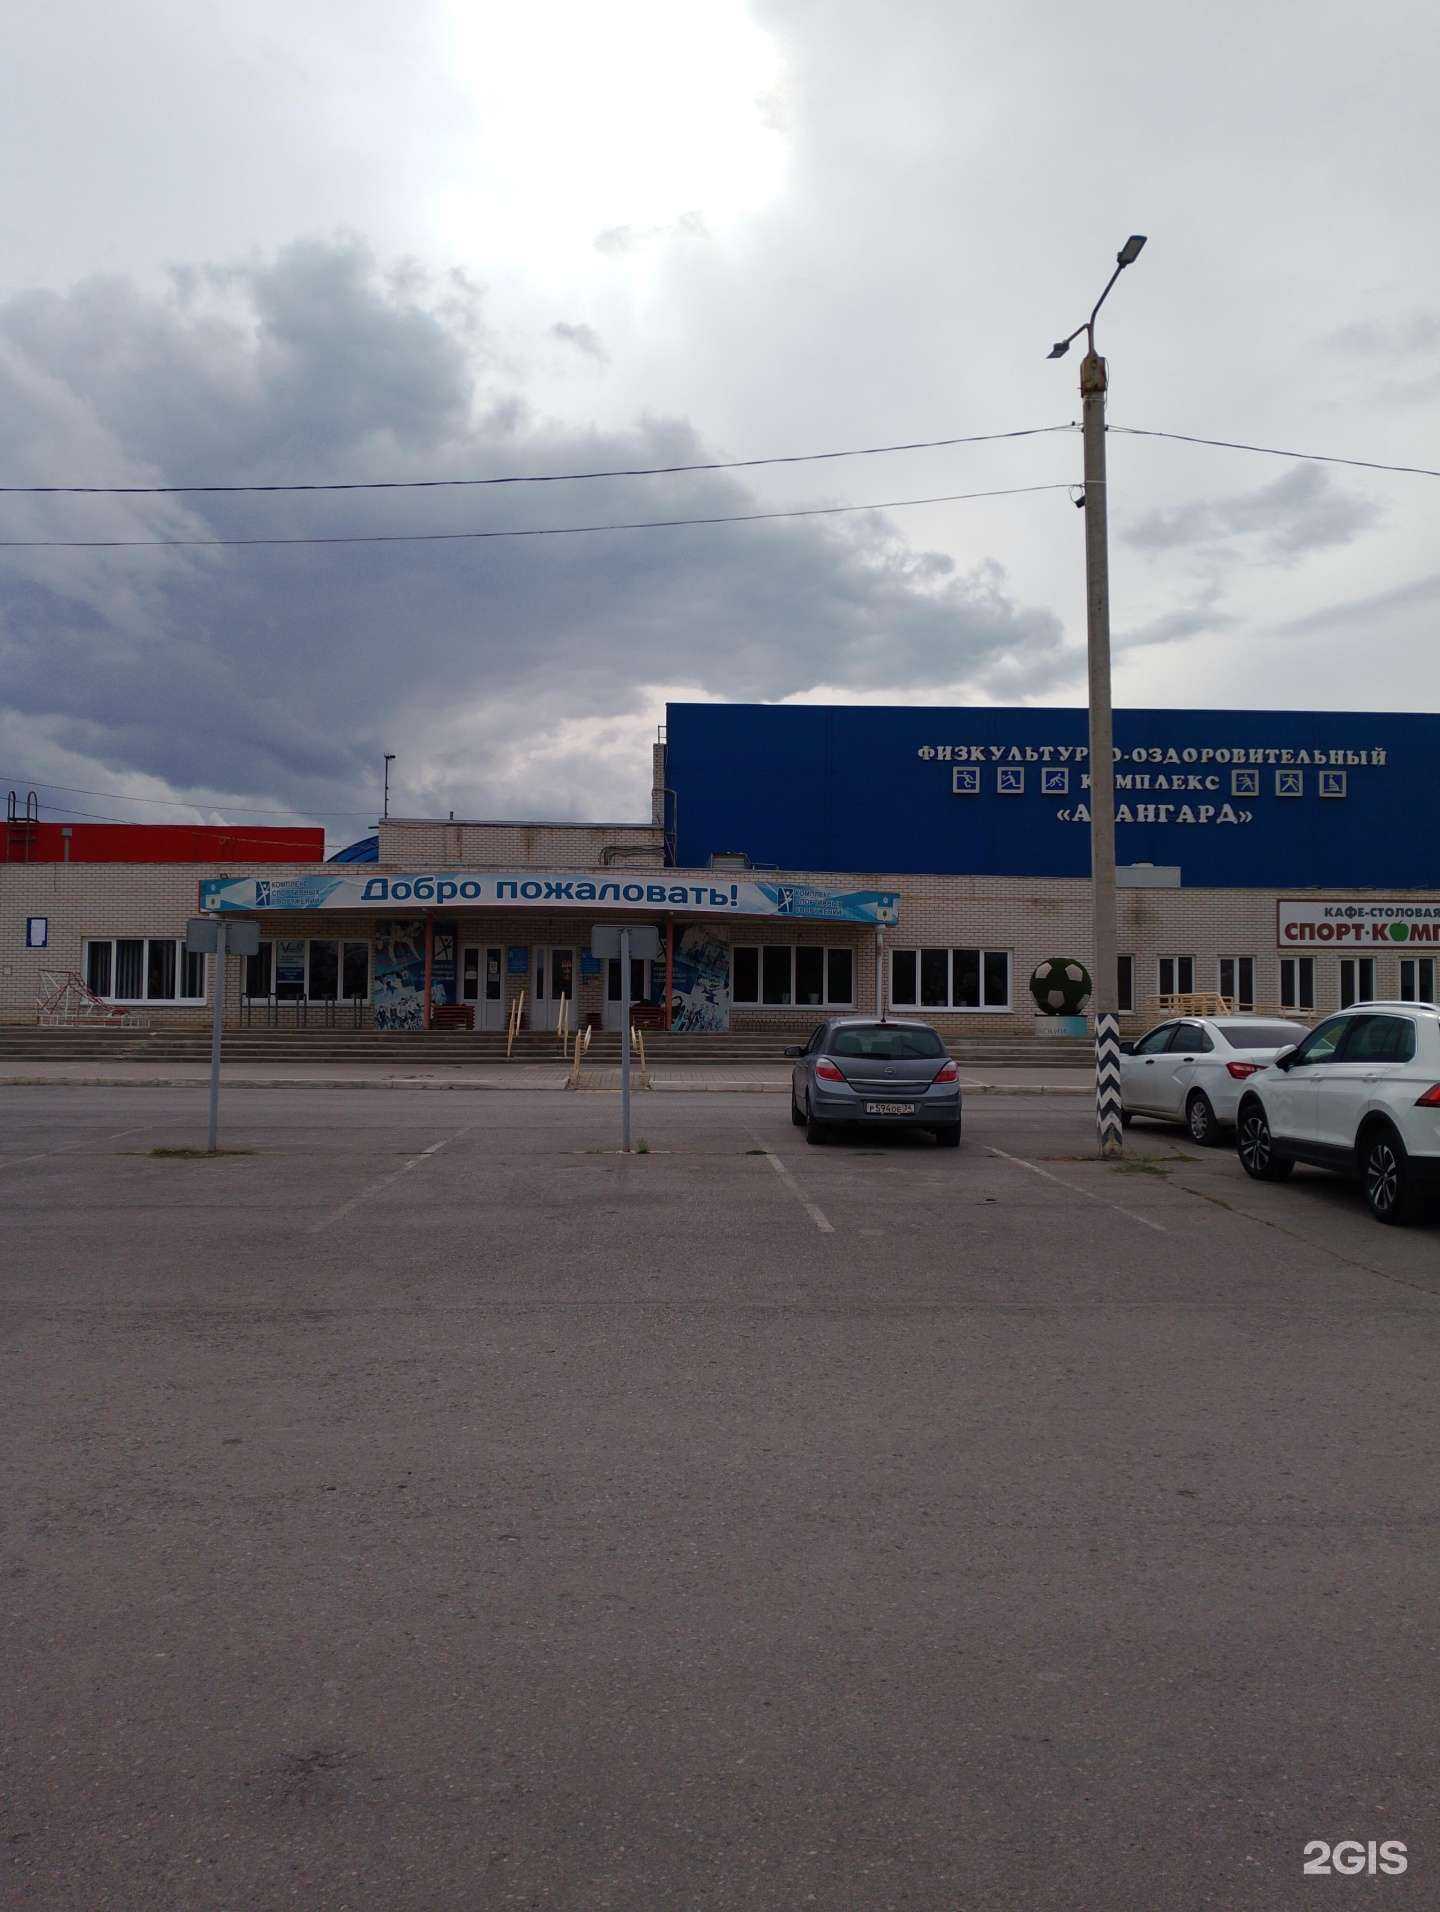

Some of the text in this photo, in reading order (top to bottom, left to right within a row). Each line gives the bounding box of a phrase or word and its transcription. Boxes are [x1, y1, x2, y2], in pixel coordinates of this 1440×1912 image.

[917, 744, 1388, 766] ФИЗКУЛЬТУРО-ОЗДОРОВИТЕЛЬНЫЙ
[1080, 773, 1221, 791] КМПЛЕКС
[1056, 803, 1253, 825] «ААНГАРД»
[361, 876, 738, 907] Добро пожаловать!
